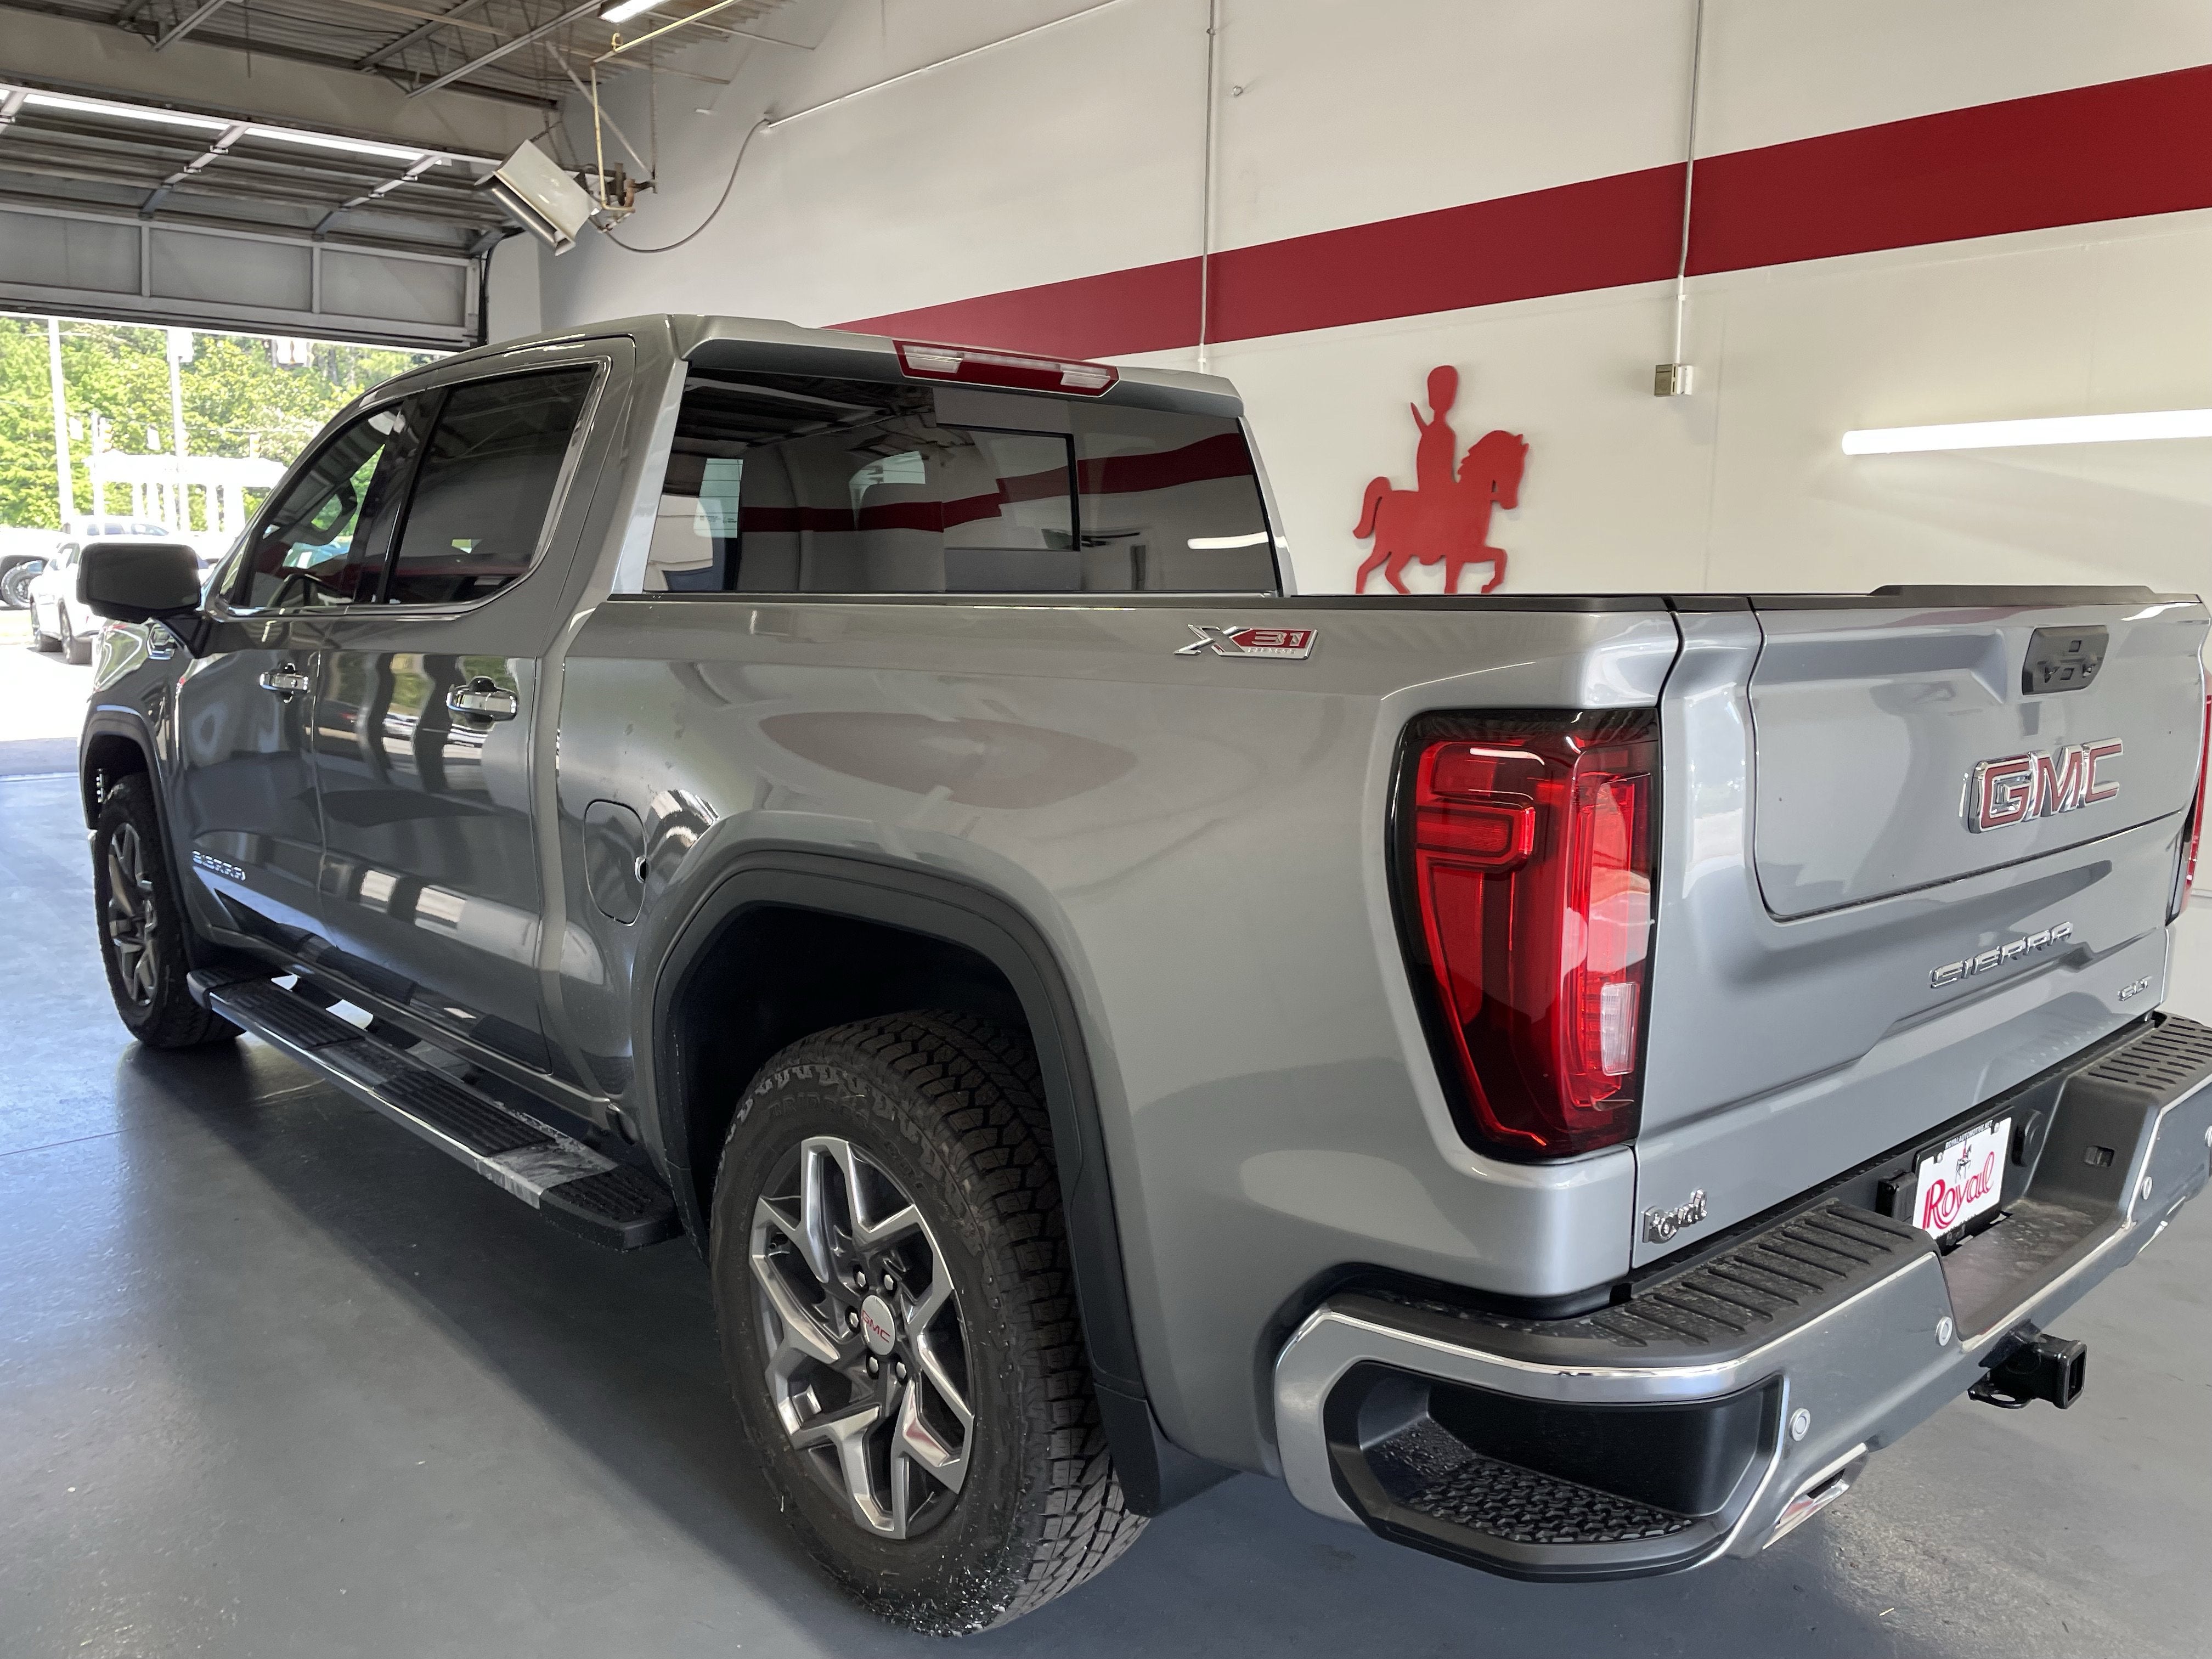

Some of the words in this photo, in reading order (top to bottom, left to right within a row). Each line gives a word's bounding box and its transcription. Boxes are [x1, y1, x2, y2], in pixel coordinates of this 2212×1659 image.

[1968, 738, 2123, 833] GMC
[1931, 922, 2072, 988] SIERRA
[1922, 1151, 1995, 1230] Royal
[862, 1310, 890, 1343] GMC
